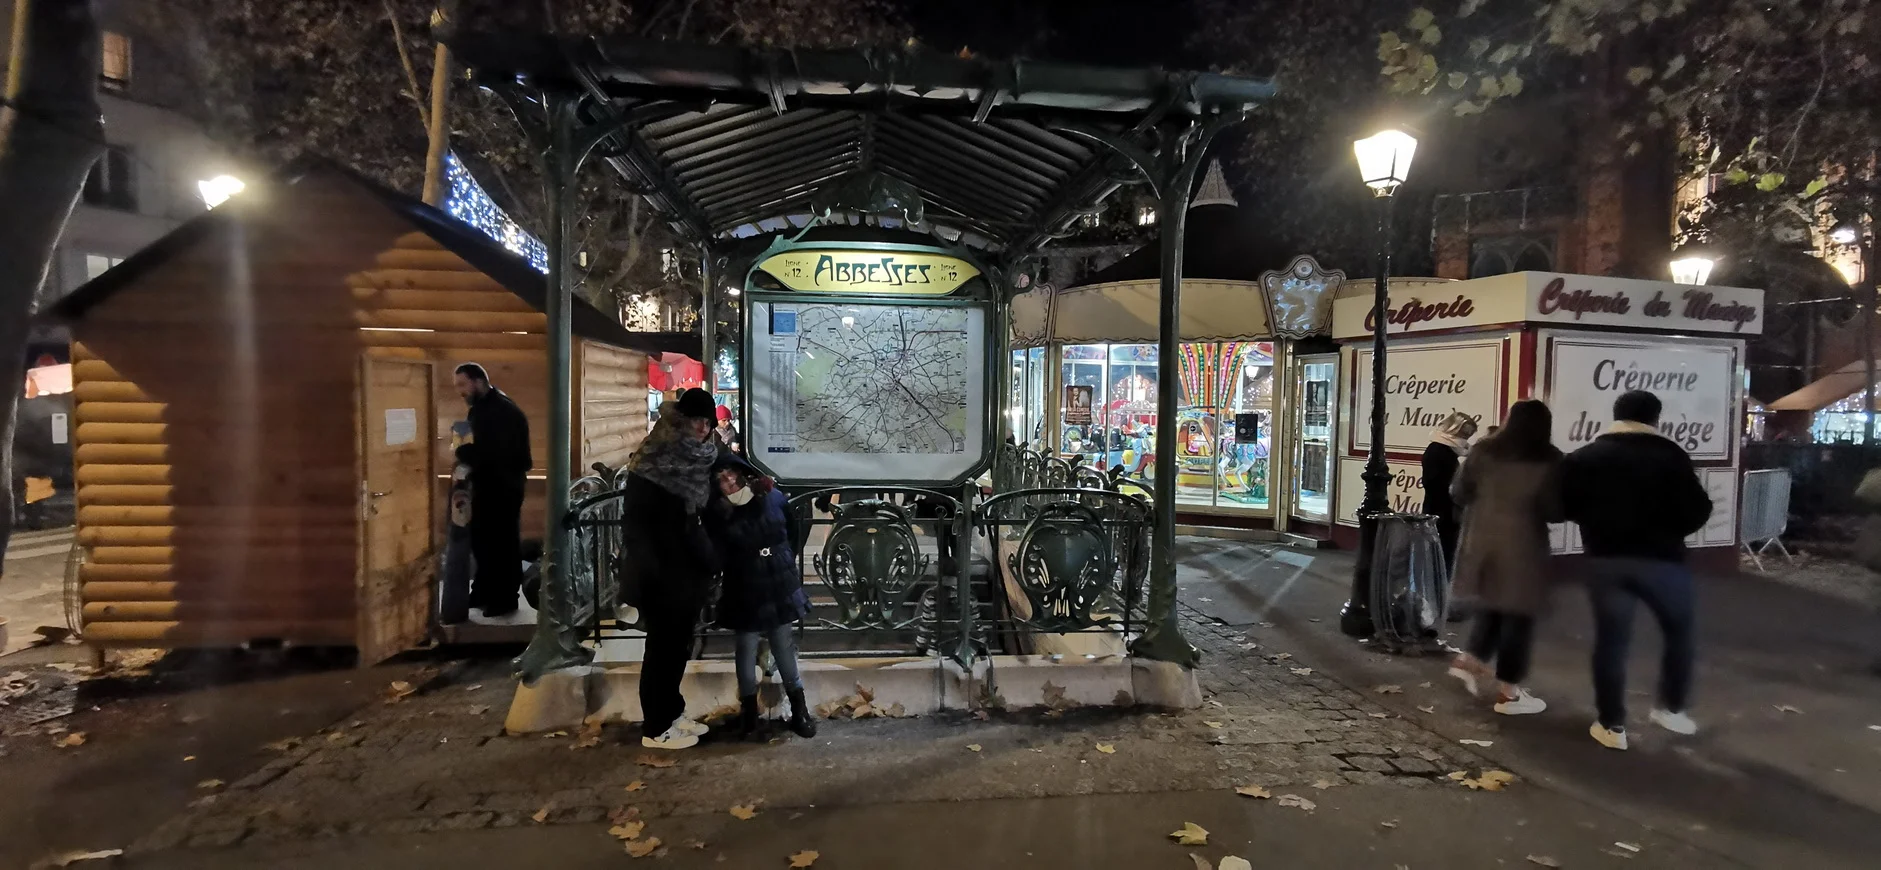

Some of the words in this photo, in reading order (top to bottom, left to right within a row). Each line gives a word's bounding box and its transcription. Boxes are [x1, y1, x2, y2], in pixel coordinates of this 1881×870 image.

[792, 268, 802, 278] 12
[814, 254, 931, 286] ABBESSES
[948, 272, 958, 282] 12
[1364, 294, 1475, 332] Crêperie
[1643, 290, 1672, 317] du
[1385, 373, 1467, 399] Crêperie
[1592, 359, 1699, 392] Crêperie
[1400, 406, 1483, 427] Mane
[1659, 413, 1715, 451] nège
